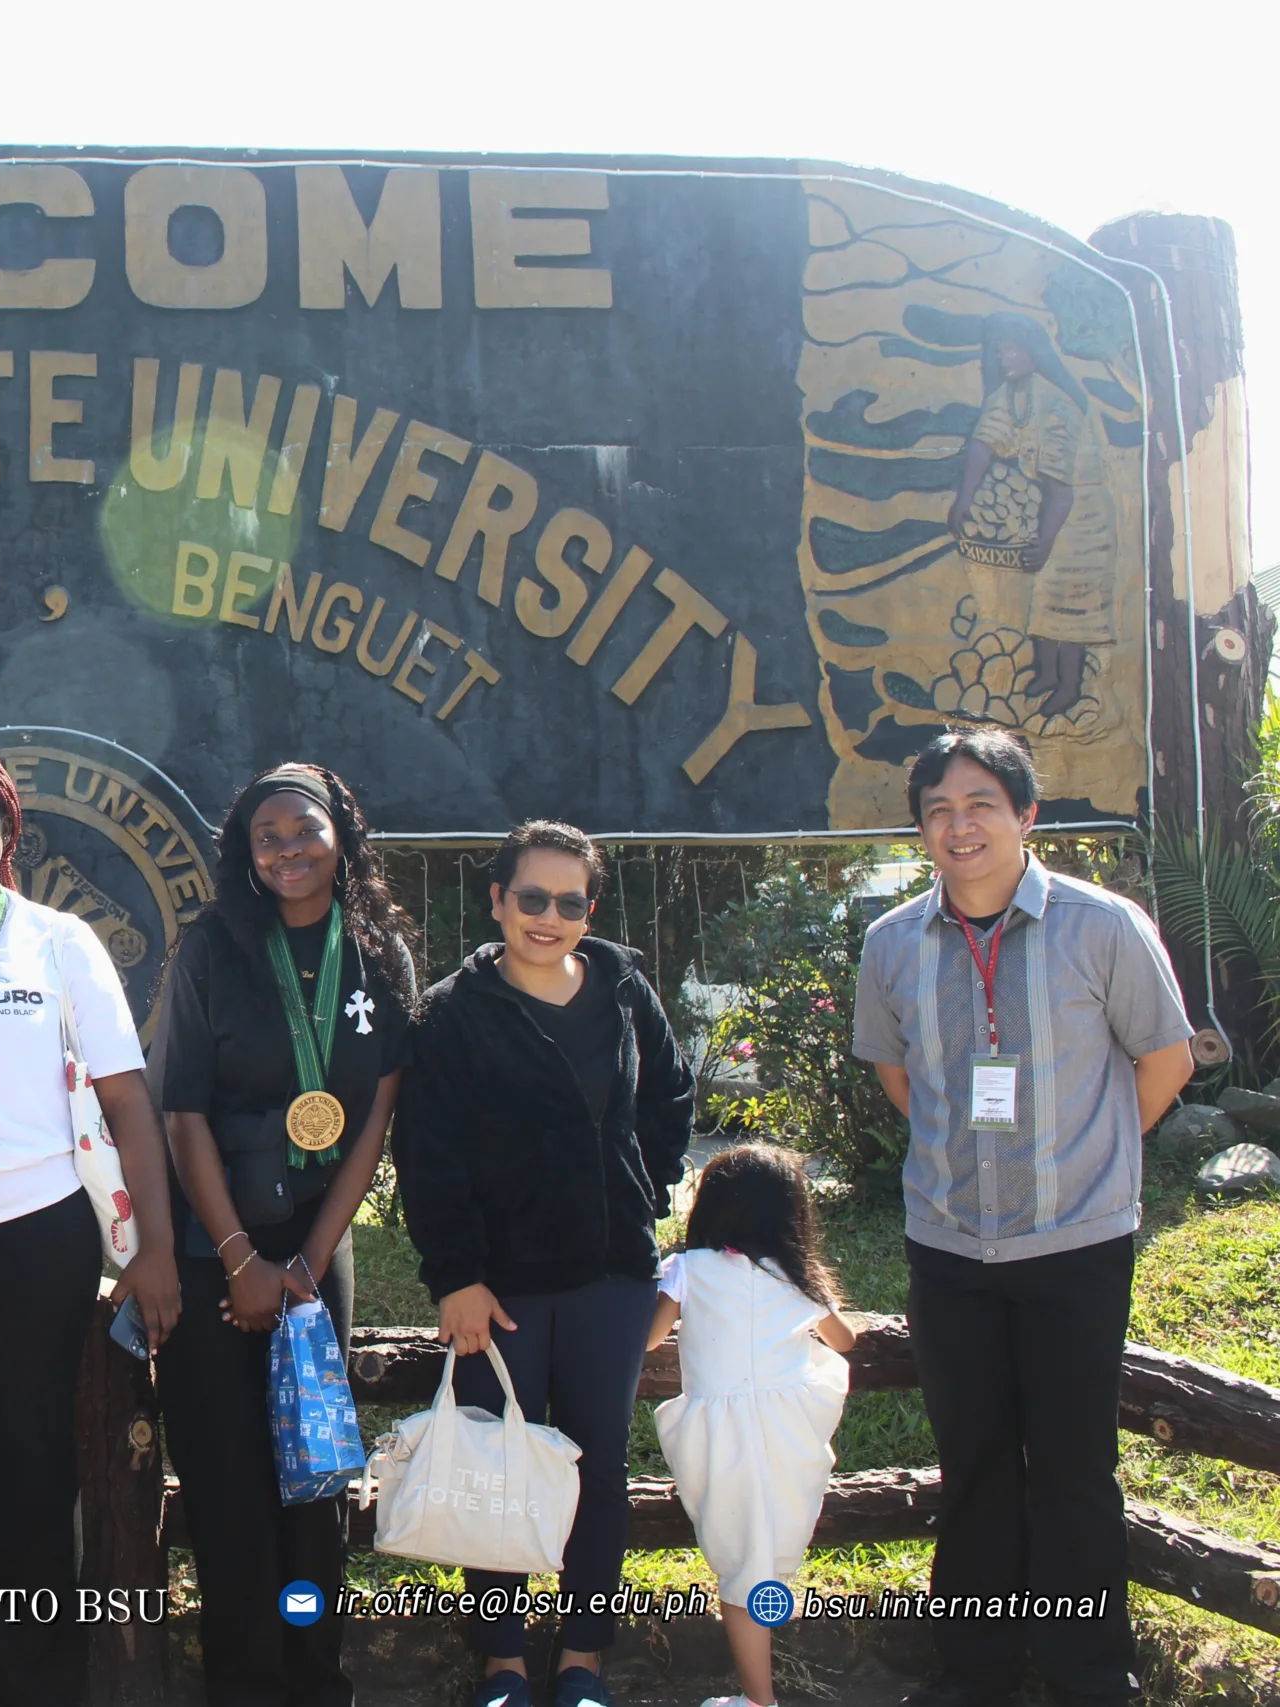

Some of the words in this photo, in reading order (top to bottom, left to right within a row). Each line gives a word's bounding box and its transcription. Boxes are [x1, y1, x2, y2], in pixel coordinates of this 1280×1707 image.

[128, 357, 813, 787] UNIVERSITY
[171, 540, 500, 722] BENGUET
[65, 760, 209, 912] UNIVE
[414, 1484, 482, 1512] TOTE
[489, 1498, 540, 1518] BAG
[456, 1467, 505, 1492] THE
